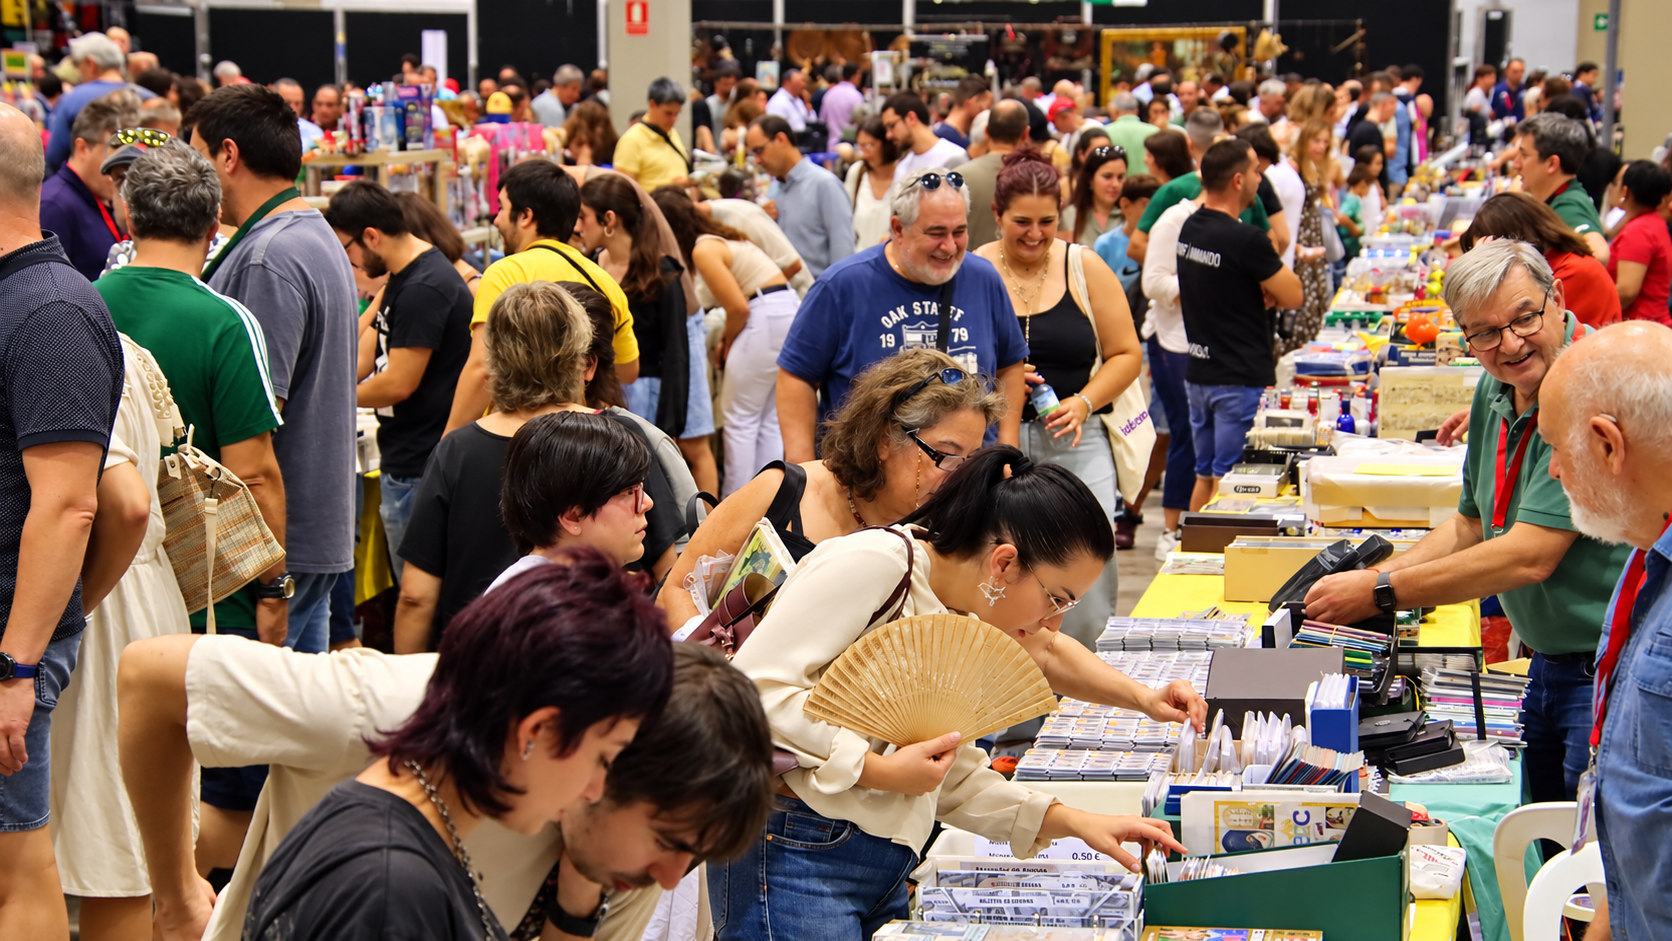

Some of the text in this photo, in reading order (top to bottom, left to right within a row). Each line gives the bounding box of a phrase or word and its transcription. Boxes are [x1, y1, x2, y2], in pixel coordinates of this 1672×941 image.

[881, 305, 909, 329] OAK
[879, 327, 969, 348] 19 79
[1072, 852, 1093, 861] 0.50
